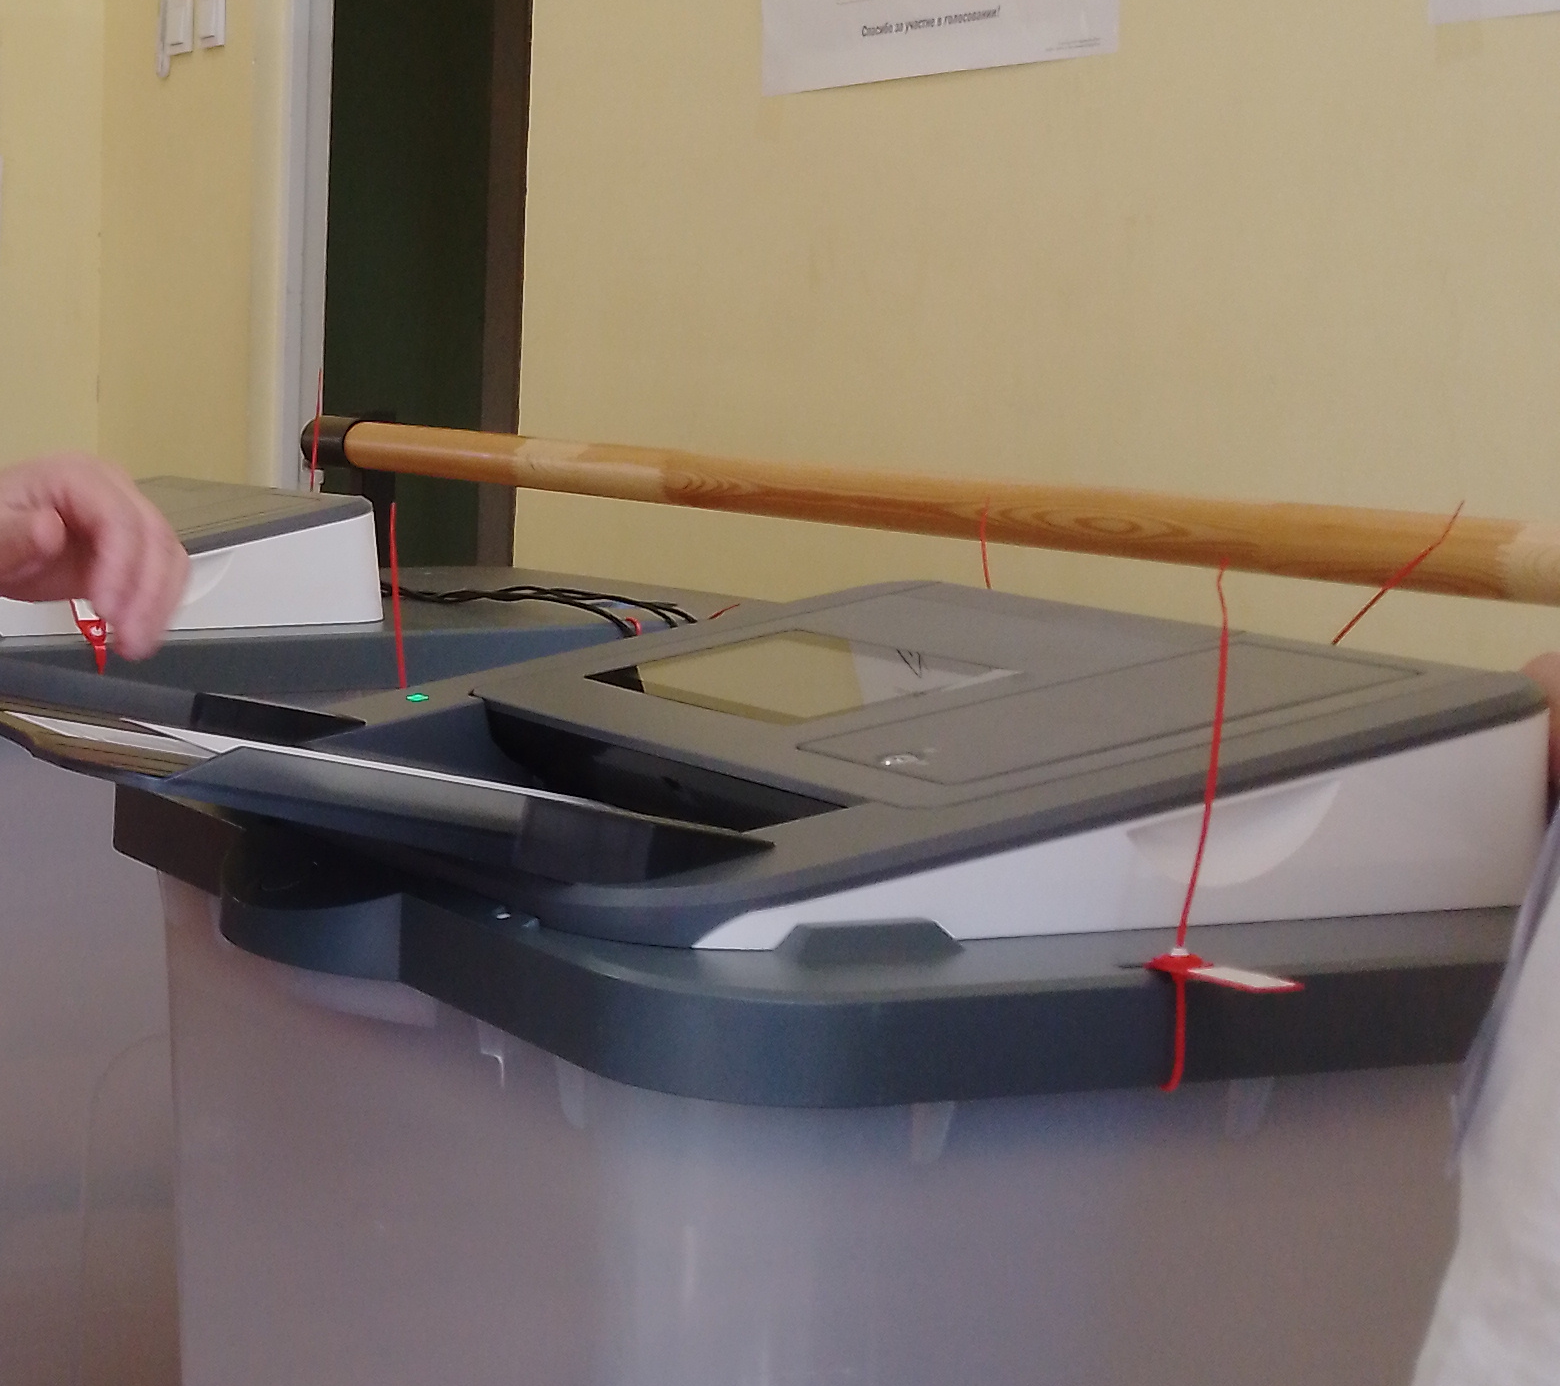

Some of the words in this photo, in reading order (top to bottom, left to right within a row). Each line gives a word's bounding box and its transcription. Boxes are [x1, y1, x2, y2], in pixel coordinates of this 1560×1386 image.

[862, 22, 893, 38] Спасибо
[894, 22, 904, 34] за
[904, 17, 935, 35] участие
[944, 5, 1001, 26] голосовании!
